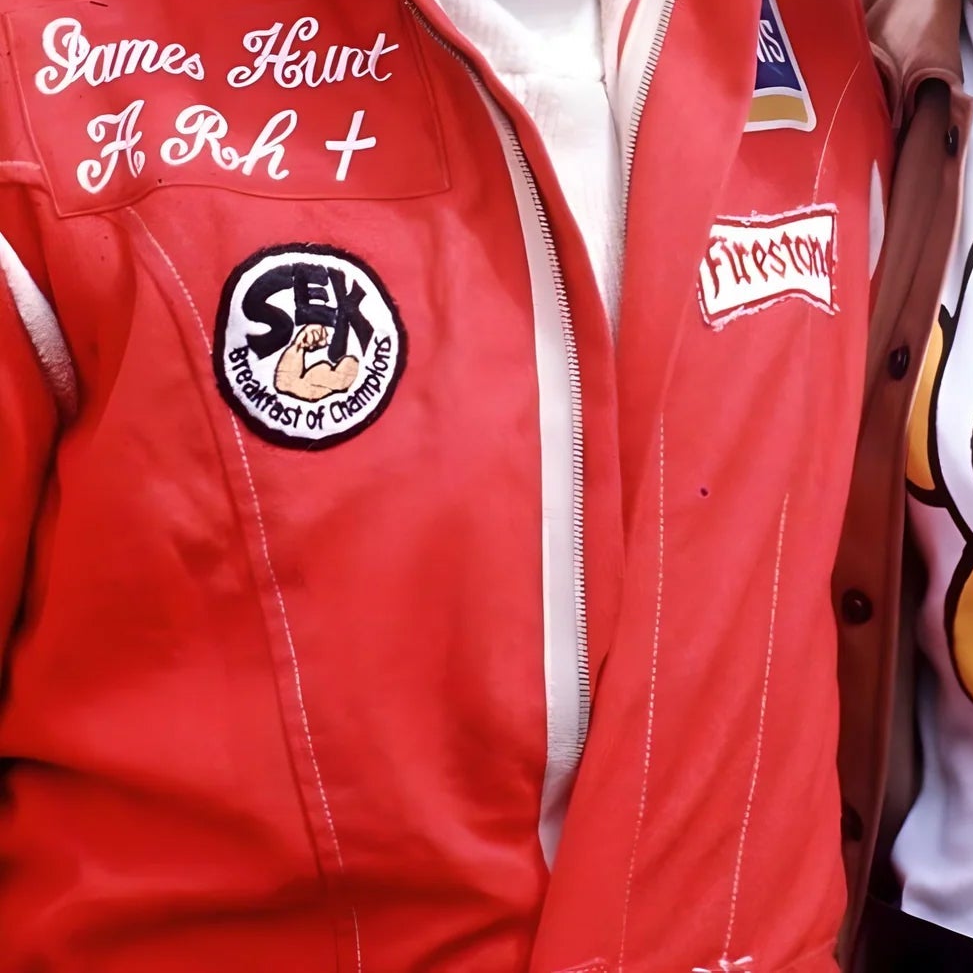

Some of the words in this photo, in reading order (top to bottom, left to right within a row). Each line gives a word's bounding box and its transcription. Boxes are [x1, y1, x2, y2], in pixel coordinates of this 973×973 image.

[35, 16, 205, 95] James
[227, 16, 399, 89] Hunt
[76, 100, 146, 194] A
[160, 104, 298, 181] Rh
[325, 109, 377, 182] +
[242, 262, 375, 364] SEK
[229, 345, 303, 429] Breakfast
[306, 406, 326, 430] of
[330, 335, 392, 424] Champions
